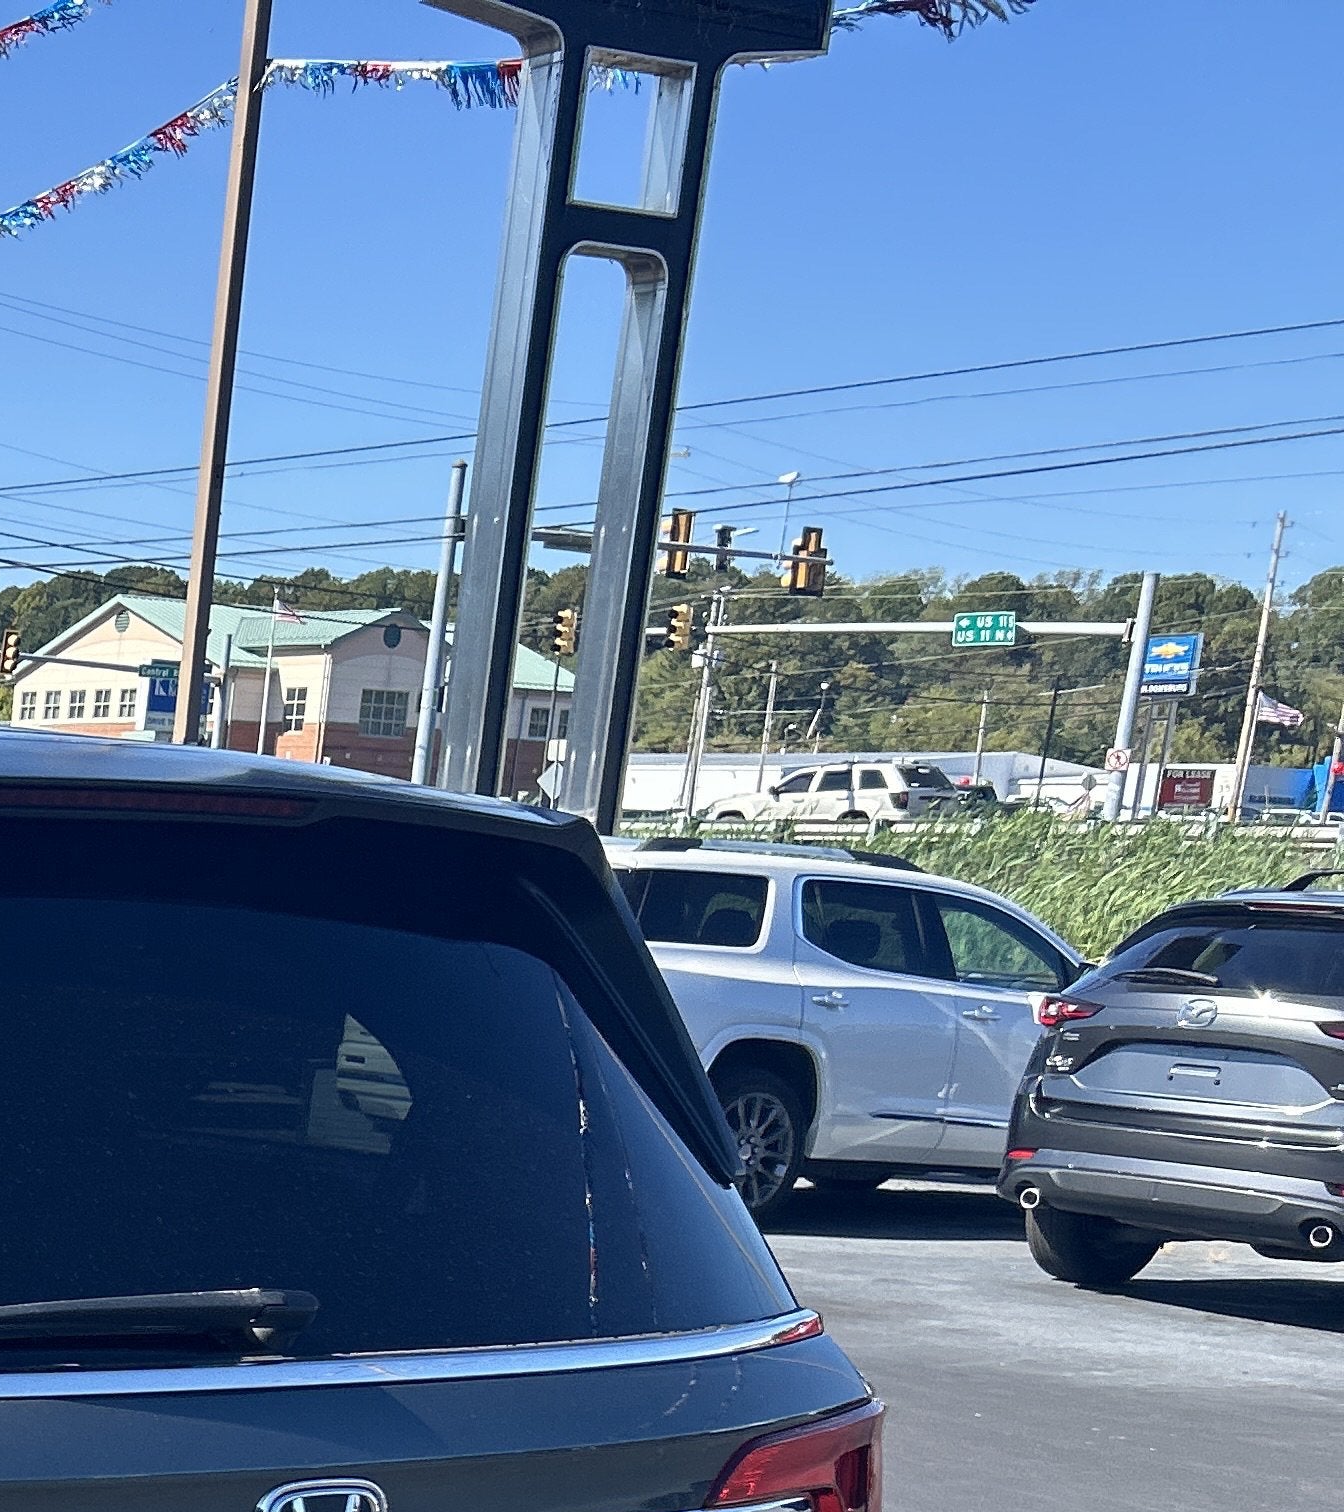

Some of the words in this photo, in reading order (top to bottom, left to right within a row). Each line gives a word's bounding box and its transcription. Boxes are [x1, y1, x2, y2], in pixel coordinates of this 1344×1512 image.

[976, 615, 993, 628] US
[956, 629, 974, 642] US
[141, 666, 169, 677] Central
[1167, 770, 1183, 778] FOR
[1185, 770, 1212, 779] LEASE
